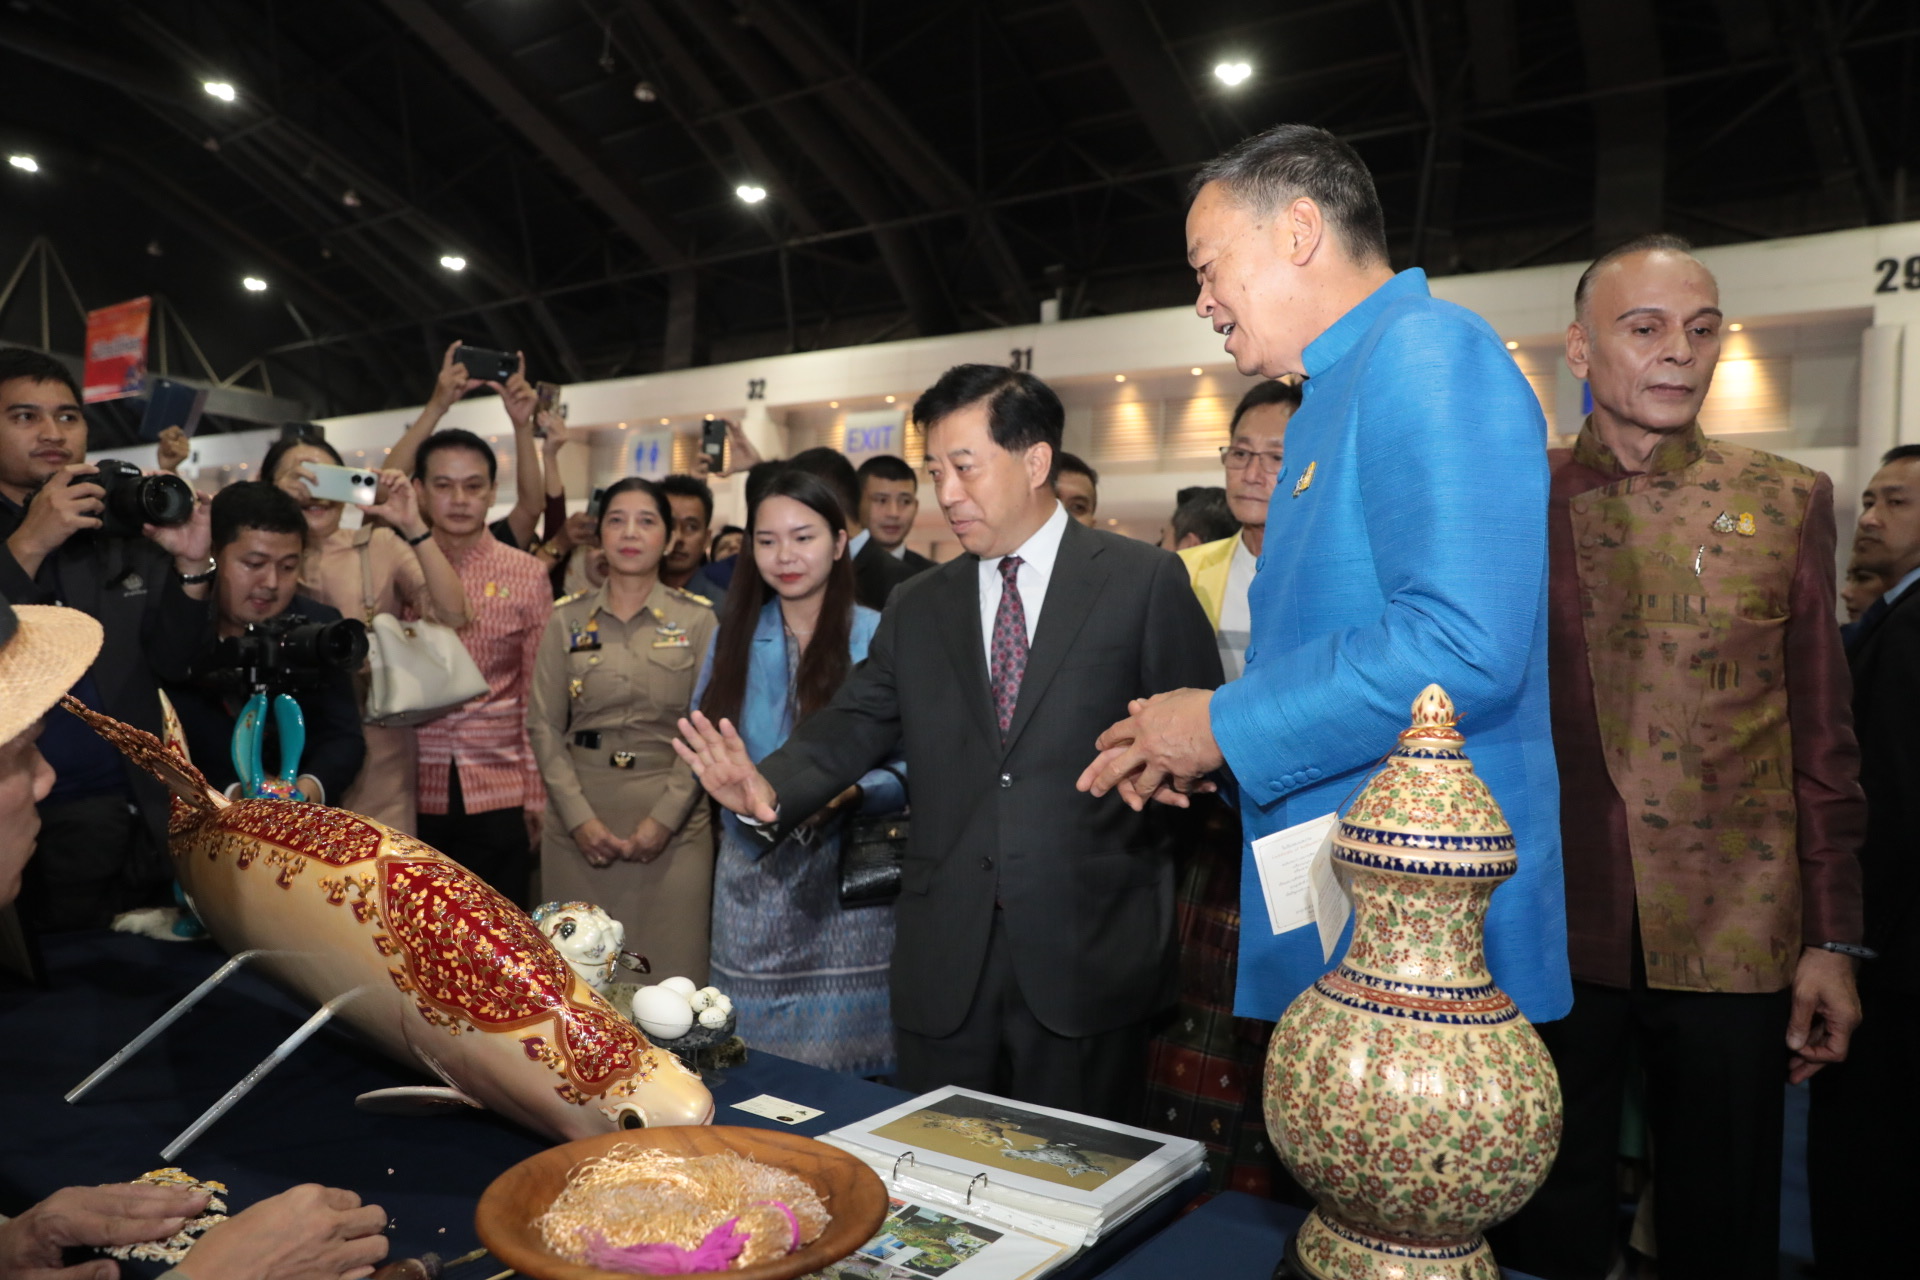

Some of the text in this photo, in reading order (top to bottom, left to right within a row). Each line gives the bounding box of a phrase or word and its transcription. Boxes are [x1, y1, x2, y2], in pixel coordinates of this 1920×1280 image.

[1875, 256, 1920, 294] 29
[1010, 347, 1032, 371] 31
[748, 379, 766, 400] 32
[847, 425, 895, 453] EXIT
